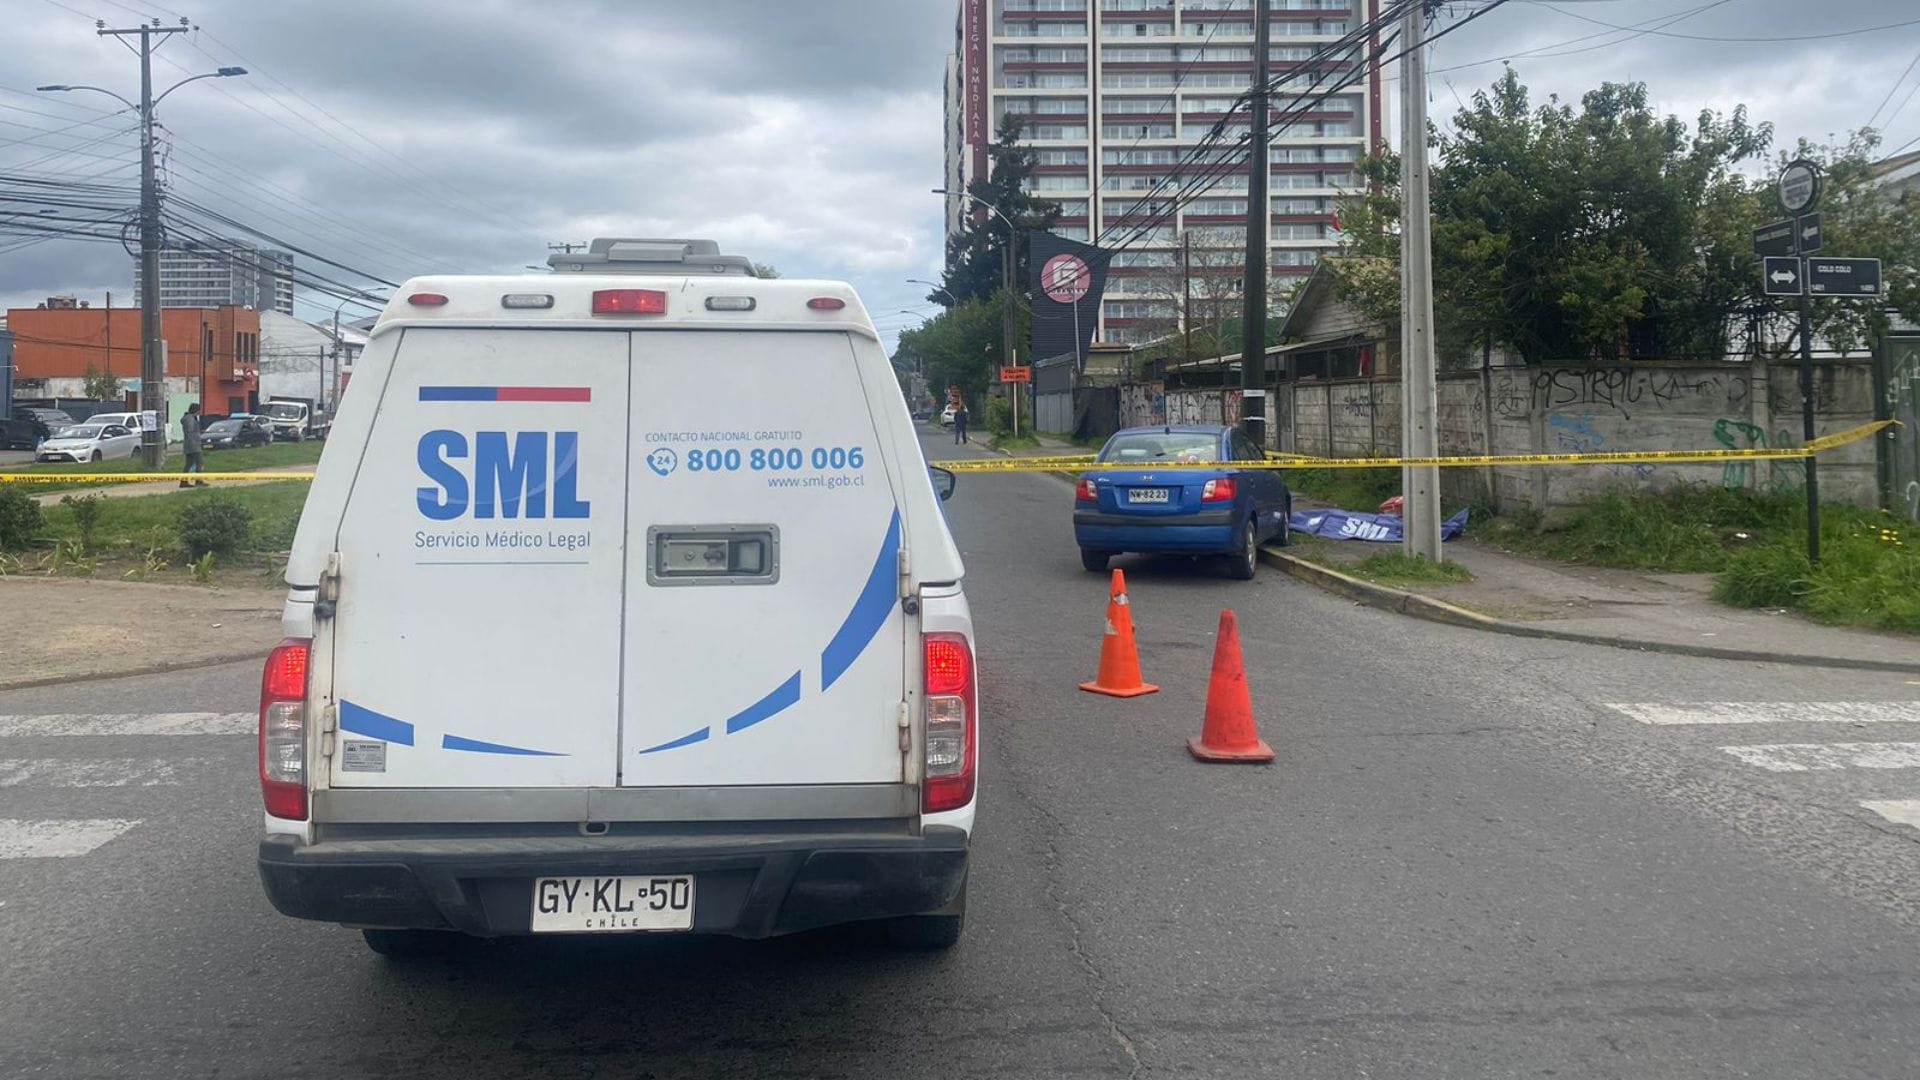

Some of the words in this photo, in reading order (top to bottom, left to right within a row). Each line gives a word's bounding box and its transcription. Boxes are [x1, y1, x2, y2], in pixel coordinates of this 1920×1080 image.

[645, 432, 698, 443] CONTACTO
[700, 431, 751, 442] NACIONAL
[754, 430, 803, 441] GRATUITO
[656, 456, 671, 466] 24
[687, 448, 741, 471] 800
[750, 448, 804, 471] 800
[811, 446, 865, 470] 006
[416, 429, 591, 521] SML
[768, 473, 865, 490] www.sml.gob.cl
[414, 531, 480, 548] Servicio
[485, 530, 543, 548] Médico
[548, 530, 591, 551] Legal
[586, 917, 639, 928] CHILE
